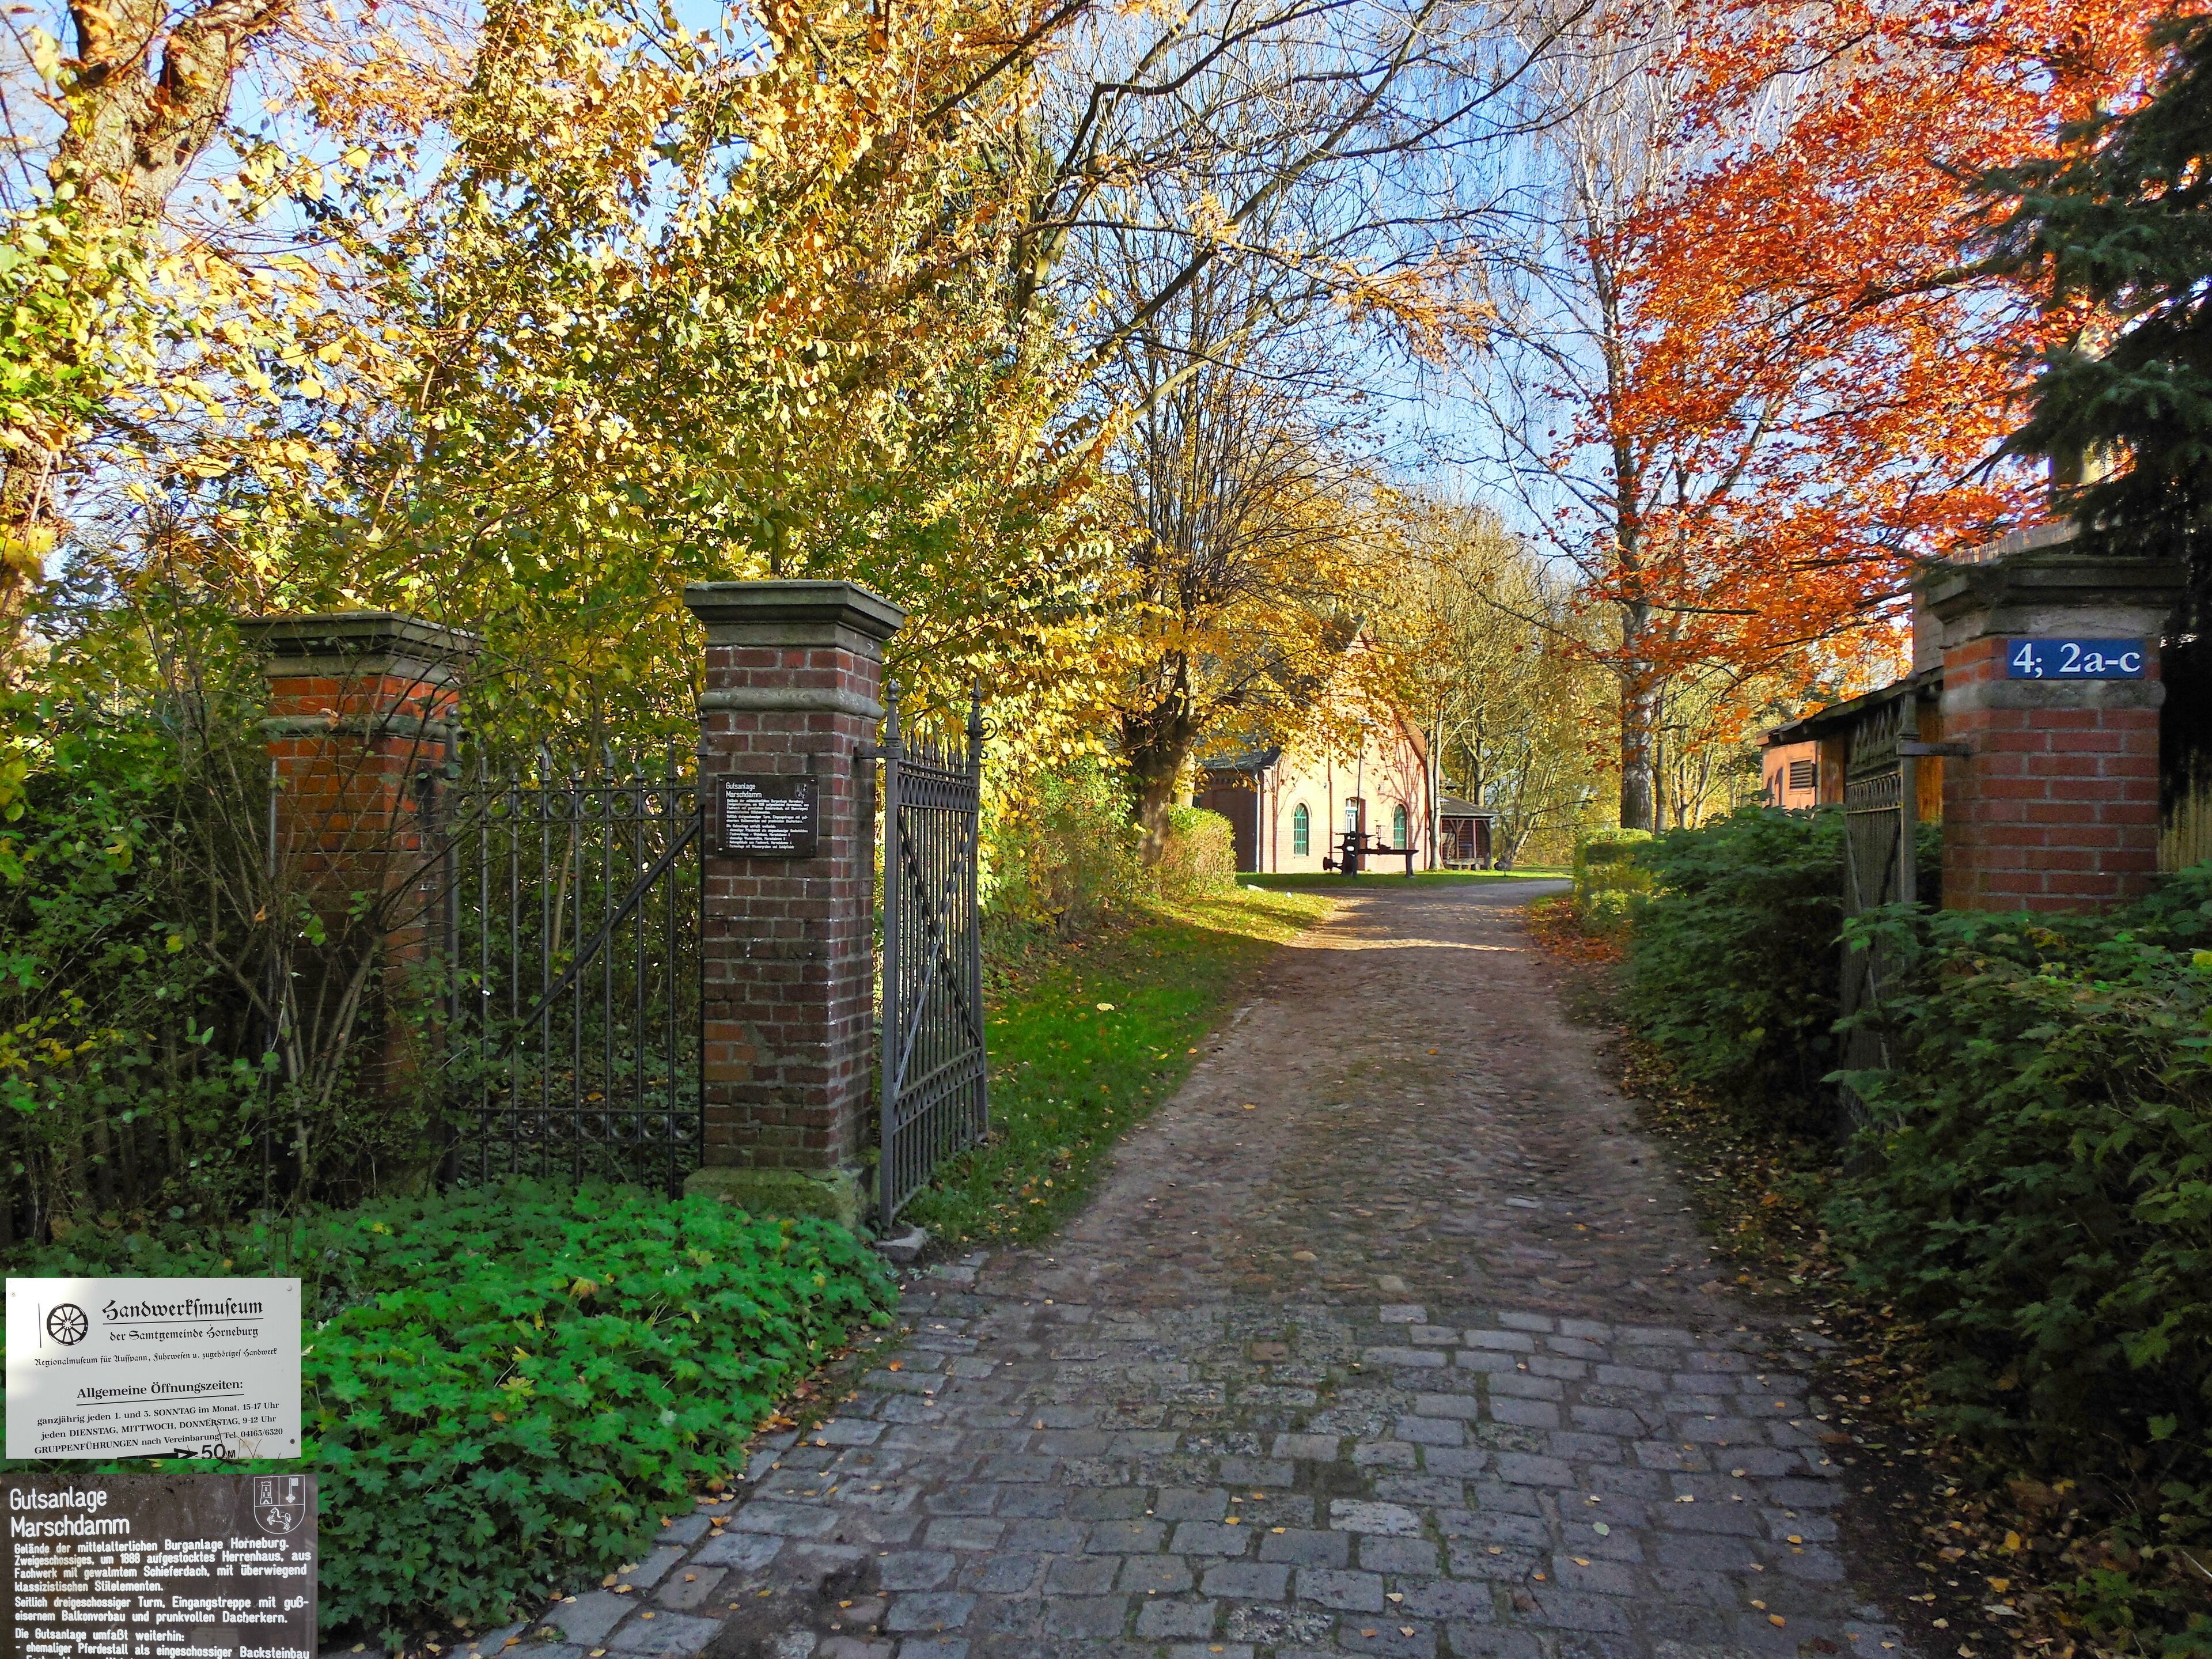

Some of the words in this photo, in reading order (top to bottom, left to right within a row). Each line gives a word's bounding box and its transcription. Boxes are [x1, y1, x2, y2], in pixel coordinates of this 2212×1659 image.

[2013, 643, 2043, 678] 4;
[2059, 643, 2141, 672] 2a-c
[725, 782, 756, 791] Gutsanlage
[726, 790, 762, 798] Marschdamm
[110, 1332, 126, 1341] der
[129, 1328, 203, 1342] Samtgemeinde
[206, 1326, 259, 1338] Horneburg
[100, 1355, 112, 1364] für
[244, 1348, 277, 1357] Handwerk
[77, 1385, 147, 1400] Allgemeine
[151, 1380, 243, 1394] Öffnungszeiten:
[37, 1415, 85, 1426] ganzjährig
[86, 1413, 111, 1423] jeden
[124, 1411, 141, 1419] und
[154, 1407, 196, 1416] SONNTAG
[213, 1404, 240, 1412] Monat,
[41, 1431, 66, 1441] jeden
[69, 1427, 118, 1437] DIENSTAG,
[122, 1423, 176, 1433] MITTWOCH,
[179, 1418, 240, 1429] DONNERSTAG,
[35, 1439, 138, 1454] GRUPPENFÜHRUNGEN
[142, 1437, 161, 1445] nach
[241, 1428, 283, 1438] 04163/6320
[10, 1486, 107, 1513] Gutsanlage
[11, 1514, 130, 1537] Marschdamm
[14, 1543, 50, 1554] Gelände
[56, 1542, 71, 1553] der
[77, 1540, 157, 1552] mittelalterlichen
[165, 1539, 224, 1553] Burganlage
[230, 1537, 289, 1551] Horneburg.
[14, 1554, 94, 1568] Zweigeschossiges,
[100, 1555, 113, 1565] um
[120, 1553, 140, 1564] 1888
[146, 1551, 215, 1566] aufgestocktes
[222, 1550, 284, 1562] Herrenhaus,
[291, 1552, 312, 1561] aus
[14, 1567, 57, 1578] Fachwerk
[63, 1567, 78, 1578] mit
[84, 1566, 137, 1580] gewalmtem
[143, 1565, 210, 1577] Schieferdach,
[217, 1565, 233, 1576] mit
[241, 1563, 307, 1578] überwiegend
[14, 1581, 88, 1592] klassizistischen
[94, 1580, 164, 1592] Stilelementen.
[15, 1596, 47, 1608] Seitlich
[54, 1596, 131, 1610] dreigeschossiger
[138, 1596, 165, 1608] Turm,
[172, 1596, 251, 1611] Eingangstreppe
[259, 1596, 276, 1608] mit
[284, 1596, 309, 1611] guß-
[15, 1610, 55, 1621] eisernem
[62, 1610, 126, 1622] Balkonvorbau
[132, 1611, 149, 1622] und
[156, 1611, 215, 1625] prunkvollen
[222, 1611, 287, 1623] Dacherkern.
[15, 1628, 29, 1639] Die
[35, 1628, 86, 1642] Gutsanlage
[93, 1629, 128, 1641] umfaßt
[135, 1630, 184, 1642] weiterhin:
[26, 1642, 72, 1656] ehemaliger
[78, 1642, 128, 1655] Pferdestall
[135, 1644, 150, 1656] als
[156, 1645, 233, 1658] eingeschossiger
[240, 1646, 309, 1659] Backsteinbau
